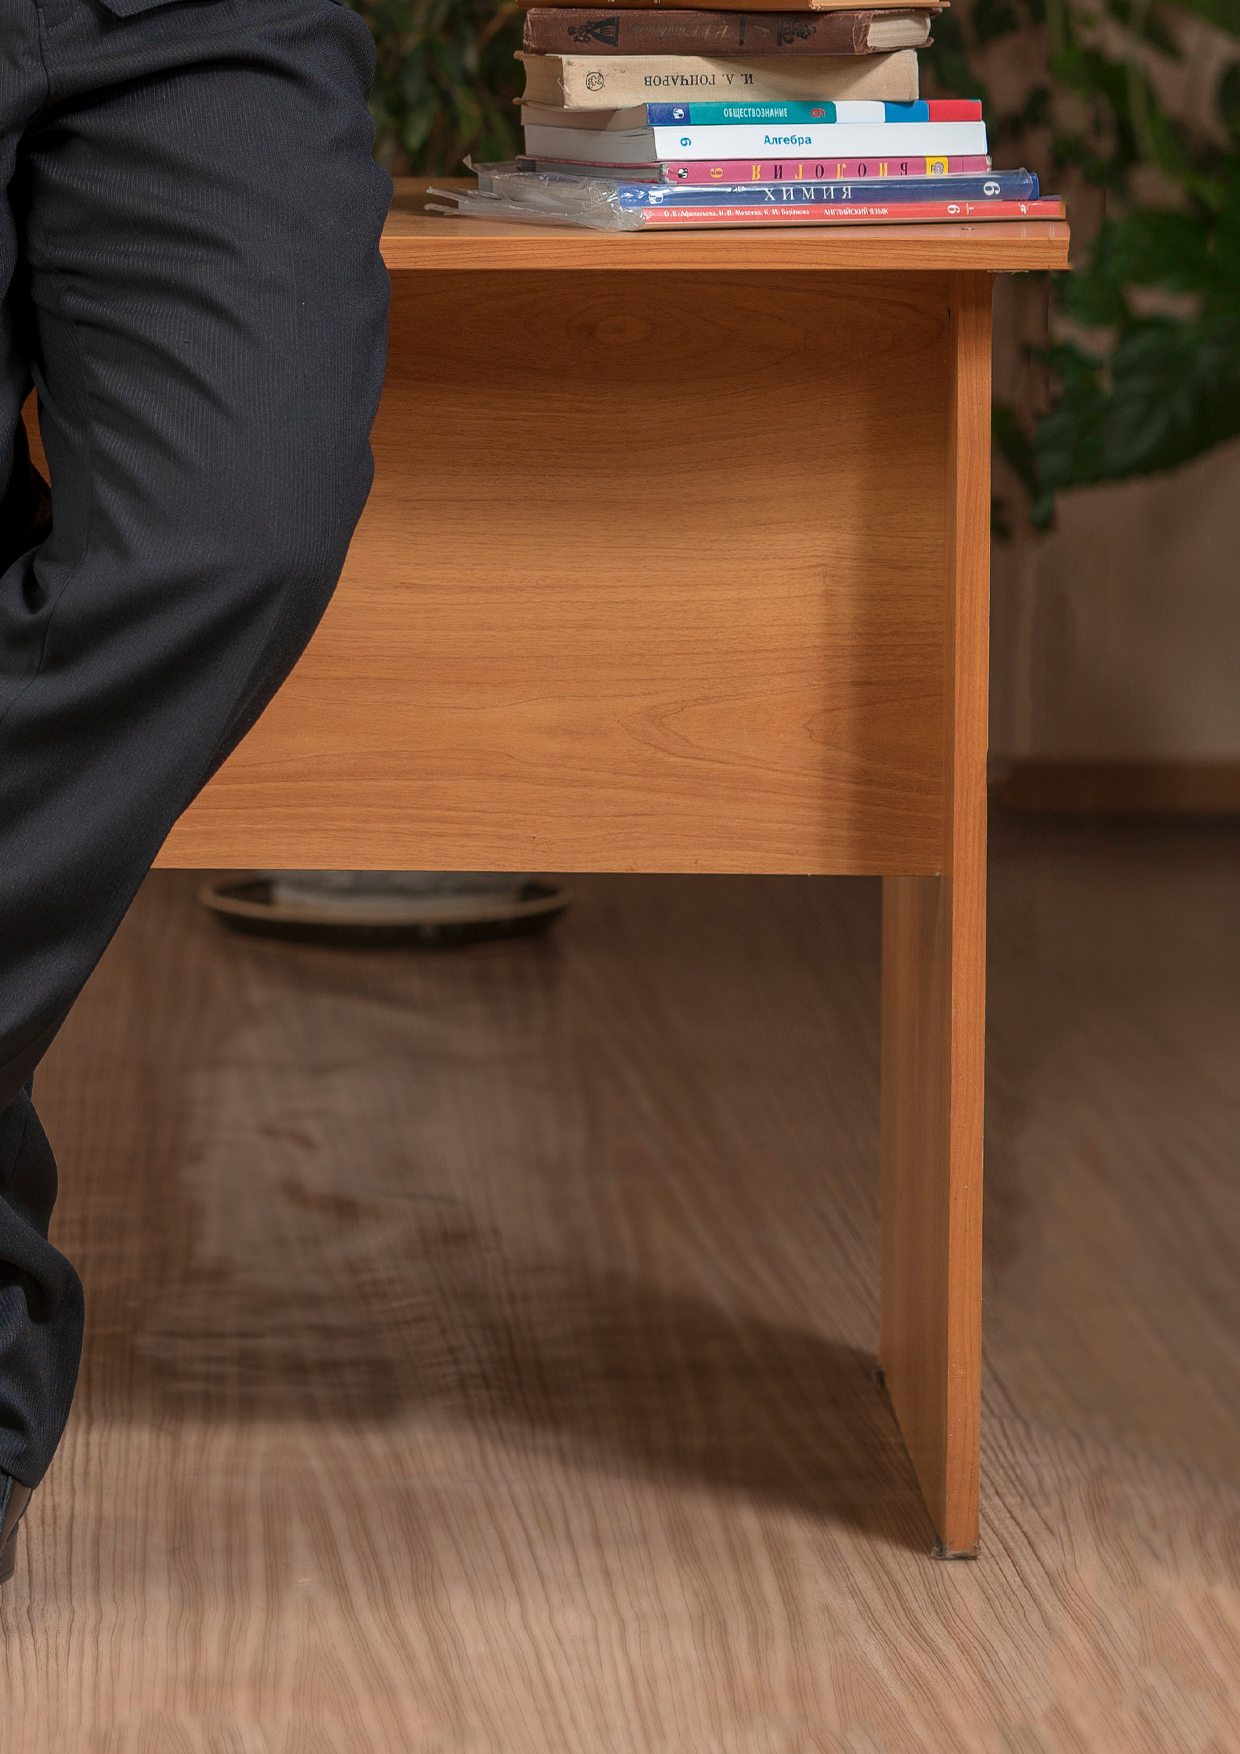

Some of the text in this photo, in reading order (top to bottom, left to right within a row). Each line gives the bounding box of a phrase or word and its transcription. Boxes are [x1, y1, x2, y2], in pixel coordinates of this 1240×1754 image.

[644, 74, 716, 87] ГОНЧАРОВ
[739, 73, 754, 86] И.
[723, 107, 788, 119] ОБЩЕСТВОЗНАНИЕ
[763, 134, 812, 147] Алгебра
[751, 162, 909, 180] БИОЛОГИЯ
[764, 186, 852, 201] ХИМИЯ
[869, 207, 889, 215] ЯЗЫК
